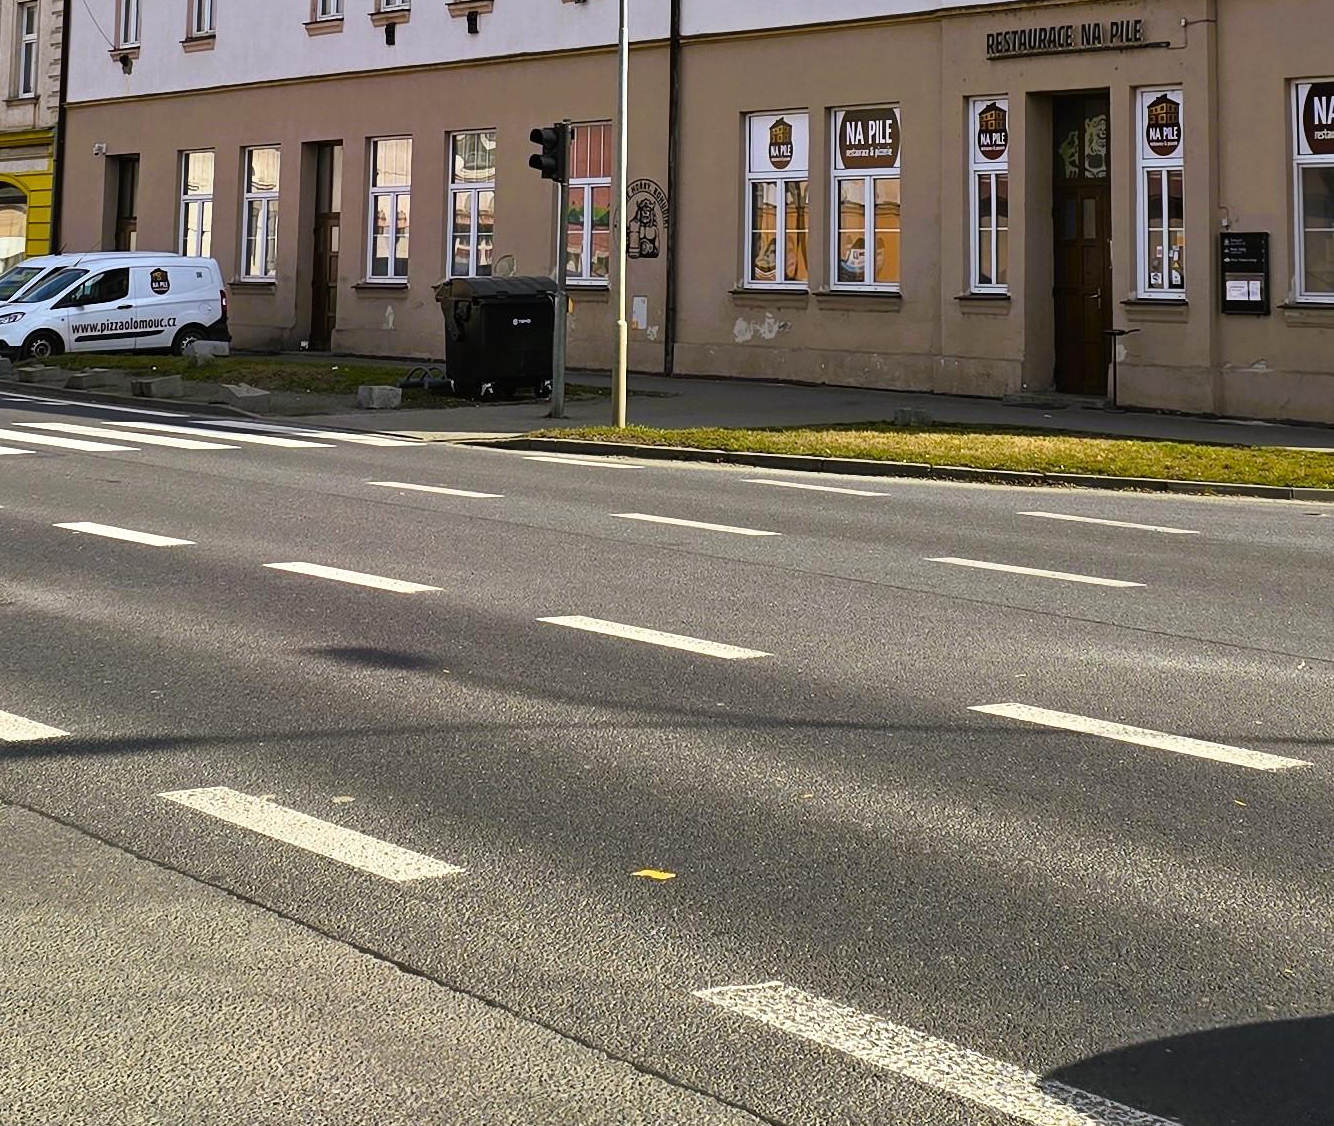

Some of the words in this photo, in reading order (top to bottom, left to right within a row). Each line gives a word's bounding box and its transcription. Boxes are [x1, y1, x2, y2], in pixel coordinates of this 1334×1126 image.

[986, 25, 1073, 55] RESTAURACE
[1081, 23, 1103, 46] NA
[1110, 19, 1143, 44] PILE
[846, 121, 865, 146] NA
[868, 119, 893, 145] PILE
[980, 132, 991, 146] NA
[992, 132, 1006, 145] PILE
[1149, 126, 1162, 141] NA
[1163, 126, 1178, 140] PILE
[770, 144, 780, 157] NA
[780, 143, 792, 156] PILE
[71, 317, 177, 334] www.pizzaolomouc.cz
